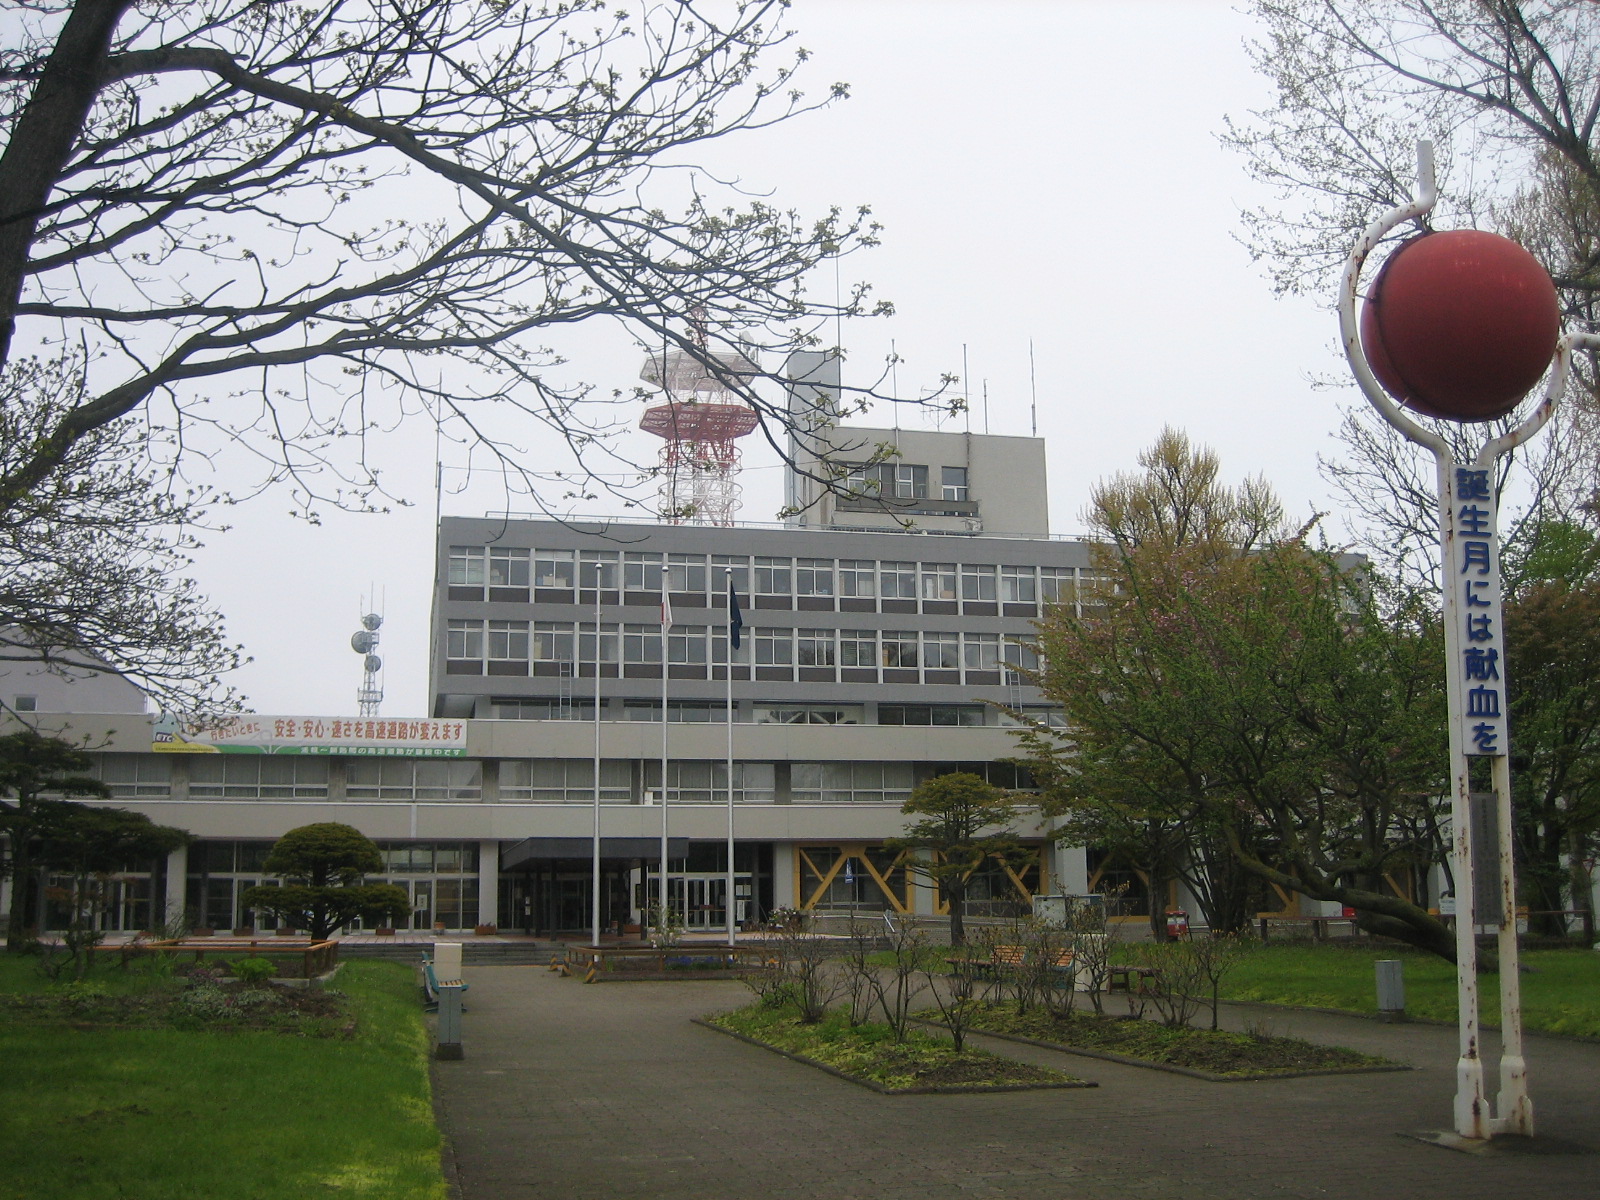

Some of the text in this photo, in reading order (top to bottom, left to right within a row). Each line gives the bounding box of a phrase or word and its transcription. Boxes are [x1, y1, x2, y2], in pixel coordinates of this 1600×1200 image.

[1456, 469, 1500, 752] 誕生月には献血を
[156, 733, 173, 742] ETC
